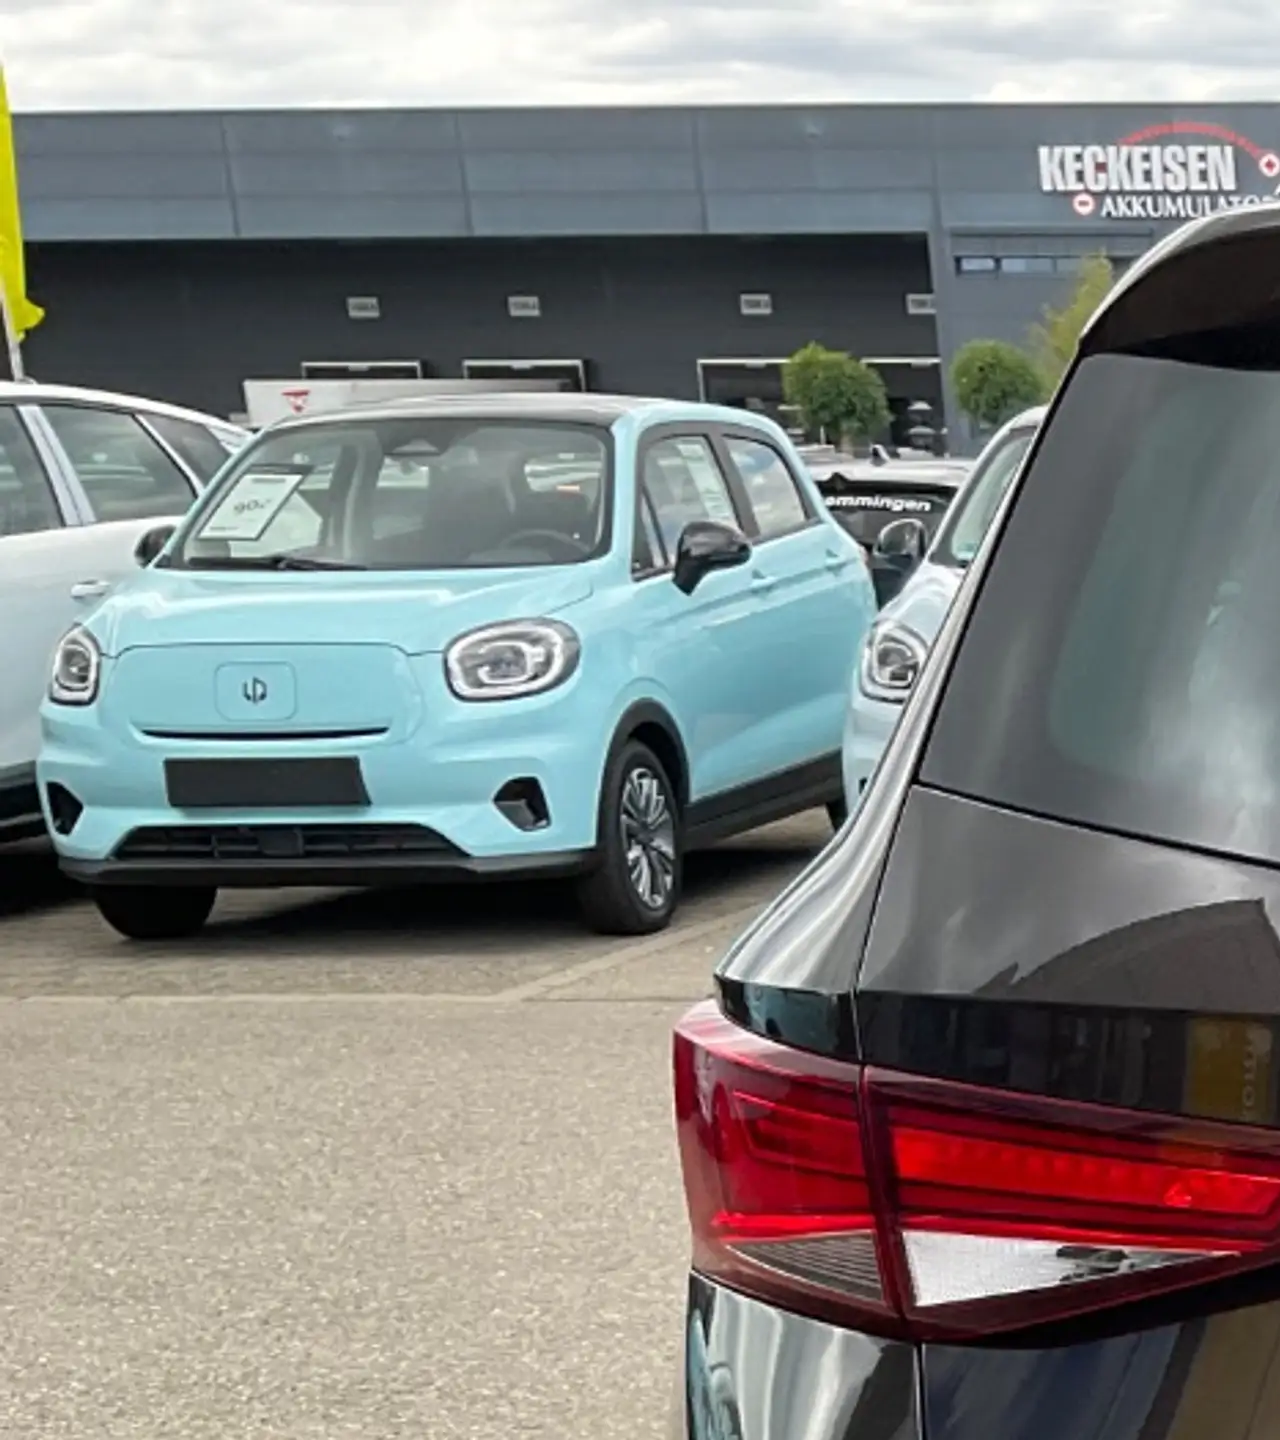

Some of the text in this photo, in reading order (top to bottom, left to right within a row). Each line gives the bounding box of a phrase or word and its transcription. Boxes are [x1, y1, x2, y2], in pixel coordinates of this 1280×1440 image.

[1038, 145, 1237, 193] KECKEISEN
[1101, 194, 1275, 219] AKKUMULATO
[826, 494, 931, 512] emmingen
